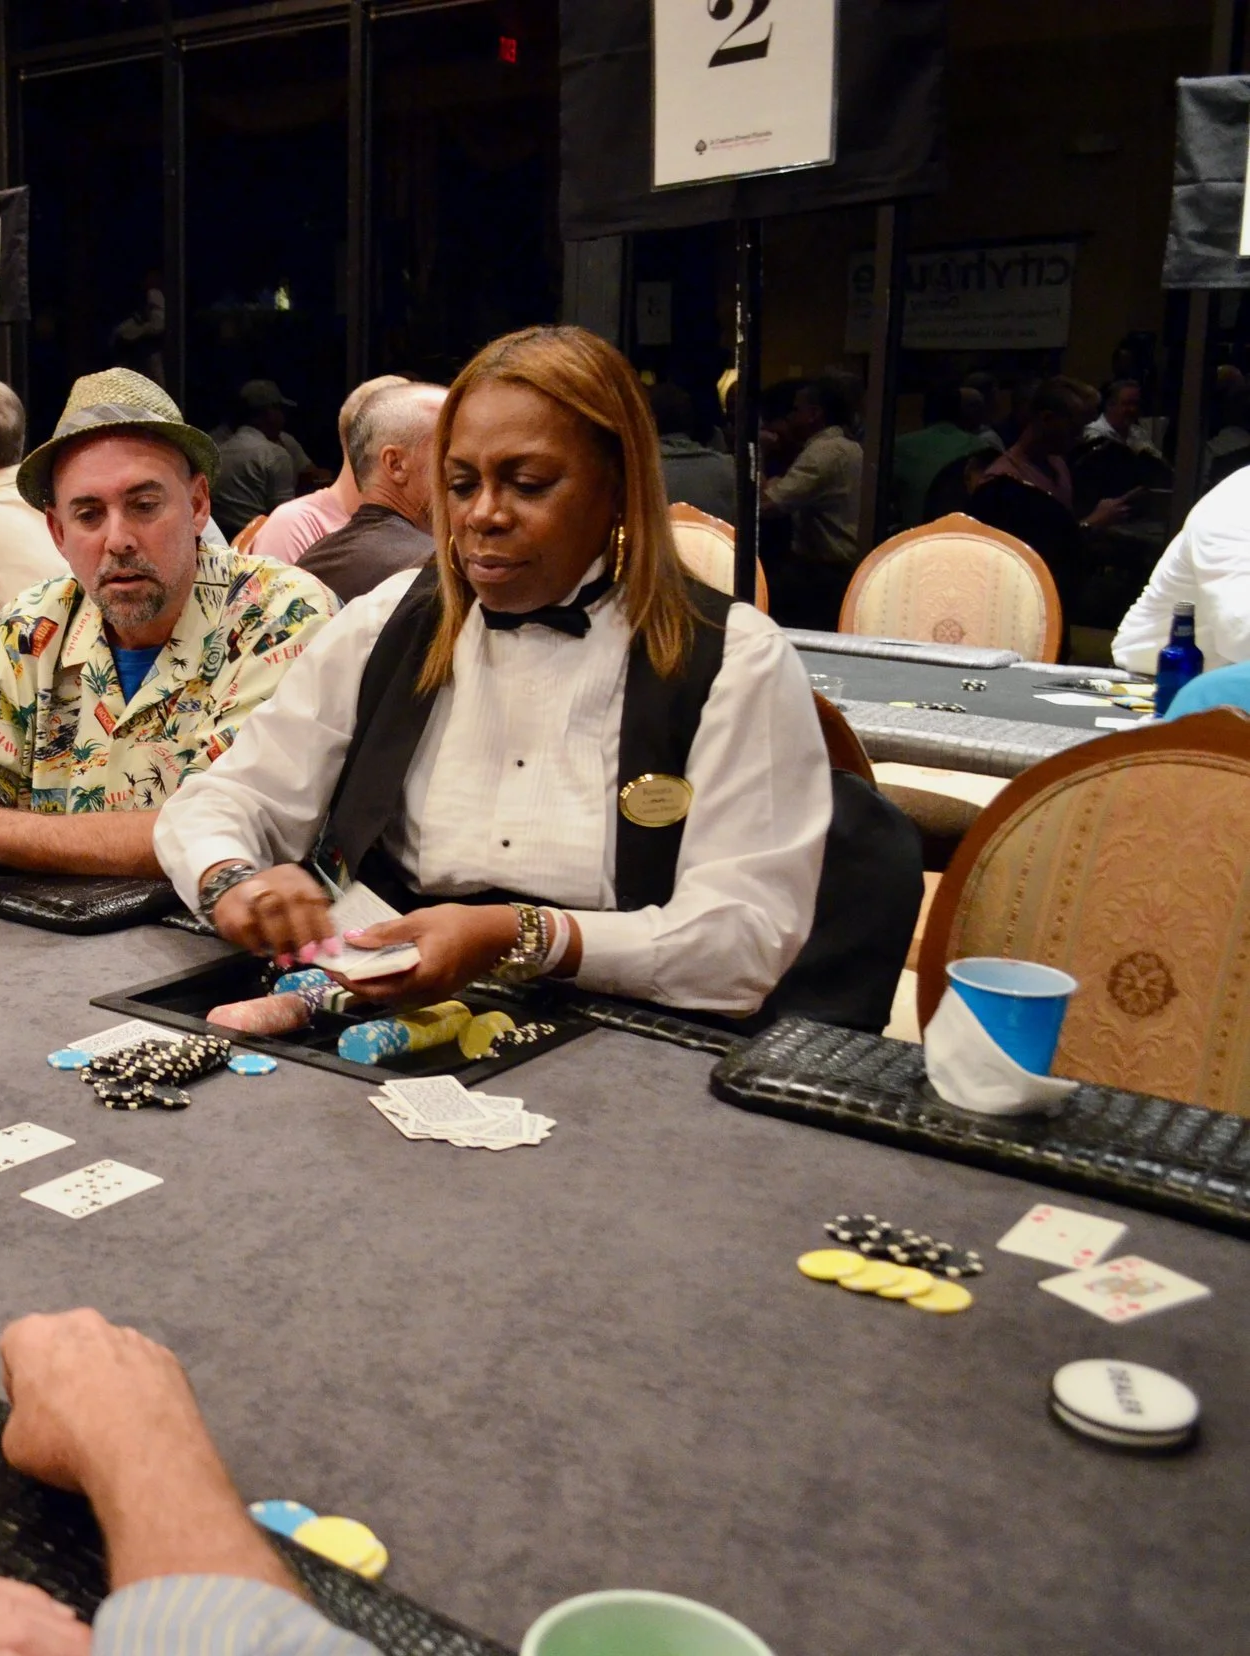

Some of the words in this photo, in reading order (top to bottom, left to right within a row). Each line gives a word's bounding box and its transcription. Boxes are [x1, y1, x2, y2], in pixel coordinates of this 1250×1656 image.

[706, 0, 774, 69] 2
[32, 622, 51, 657] FLORIDA
[66, 611, 92, 657] Turnpike
[262, 642, 309, 667] YEEH
[1106, 1366, 1144, 1416] DEALER
